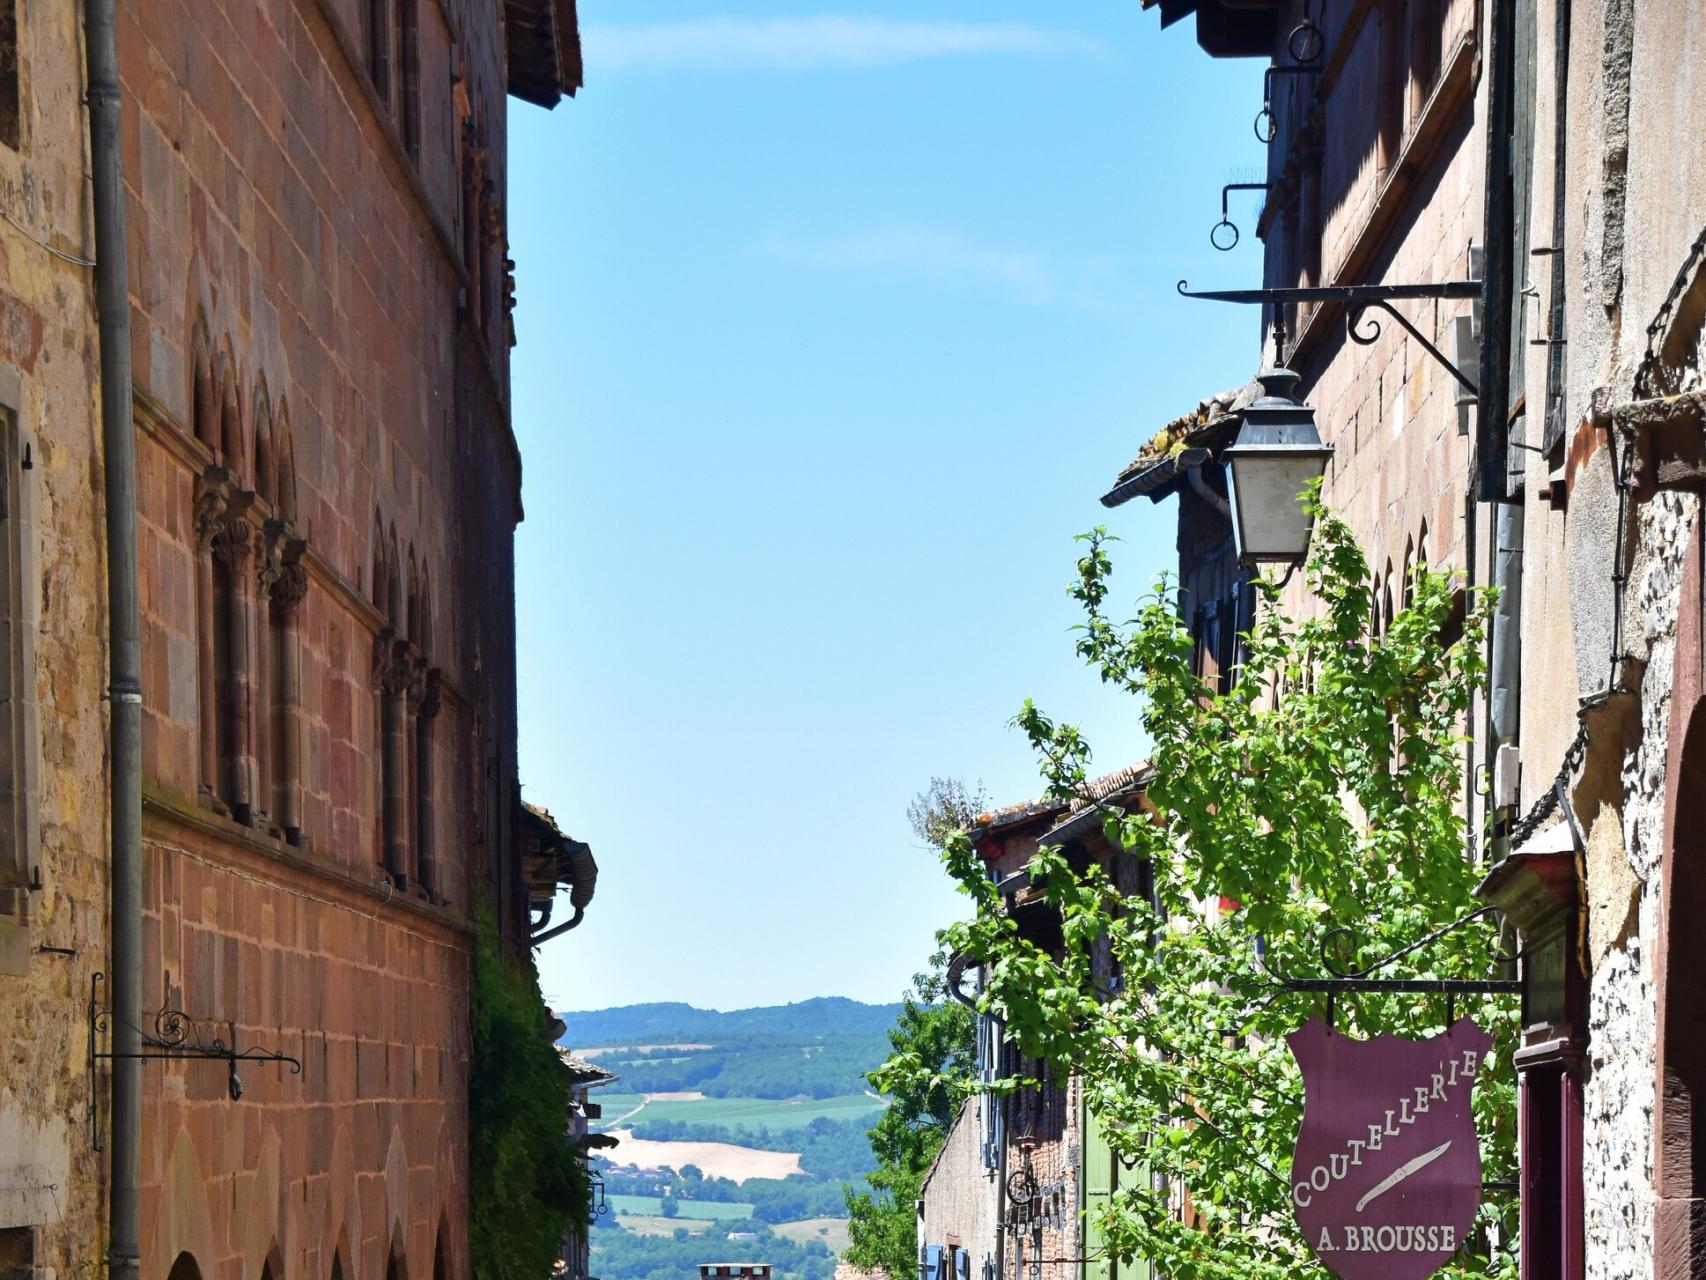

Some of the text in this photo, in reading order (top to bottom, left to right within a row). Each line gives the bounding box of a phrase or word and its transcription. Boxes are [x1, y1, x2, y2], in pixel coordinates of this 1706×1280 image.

[1293, 1050, 1477, 1208] COUTELLERIE
[1316, 1225, 1456, 1253] A. BROUSSE
